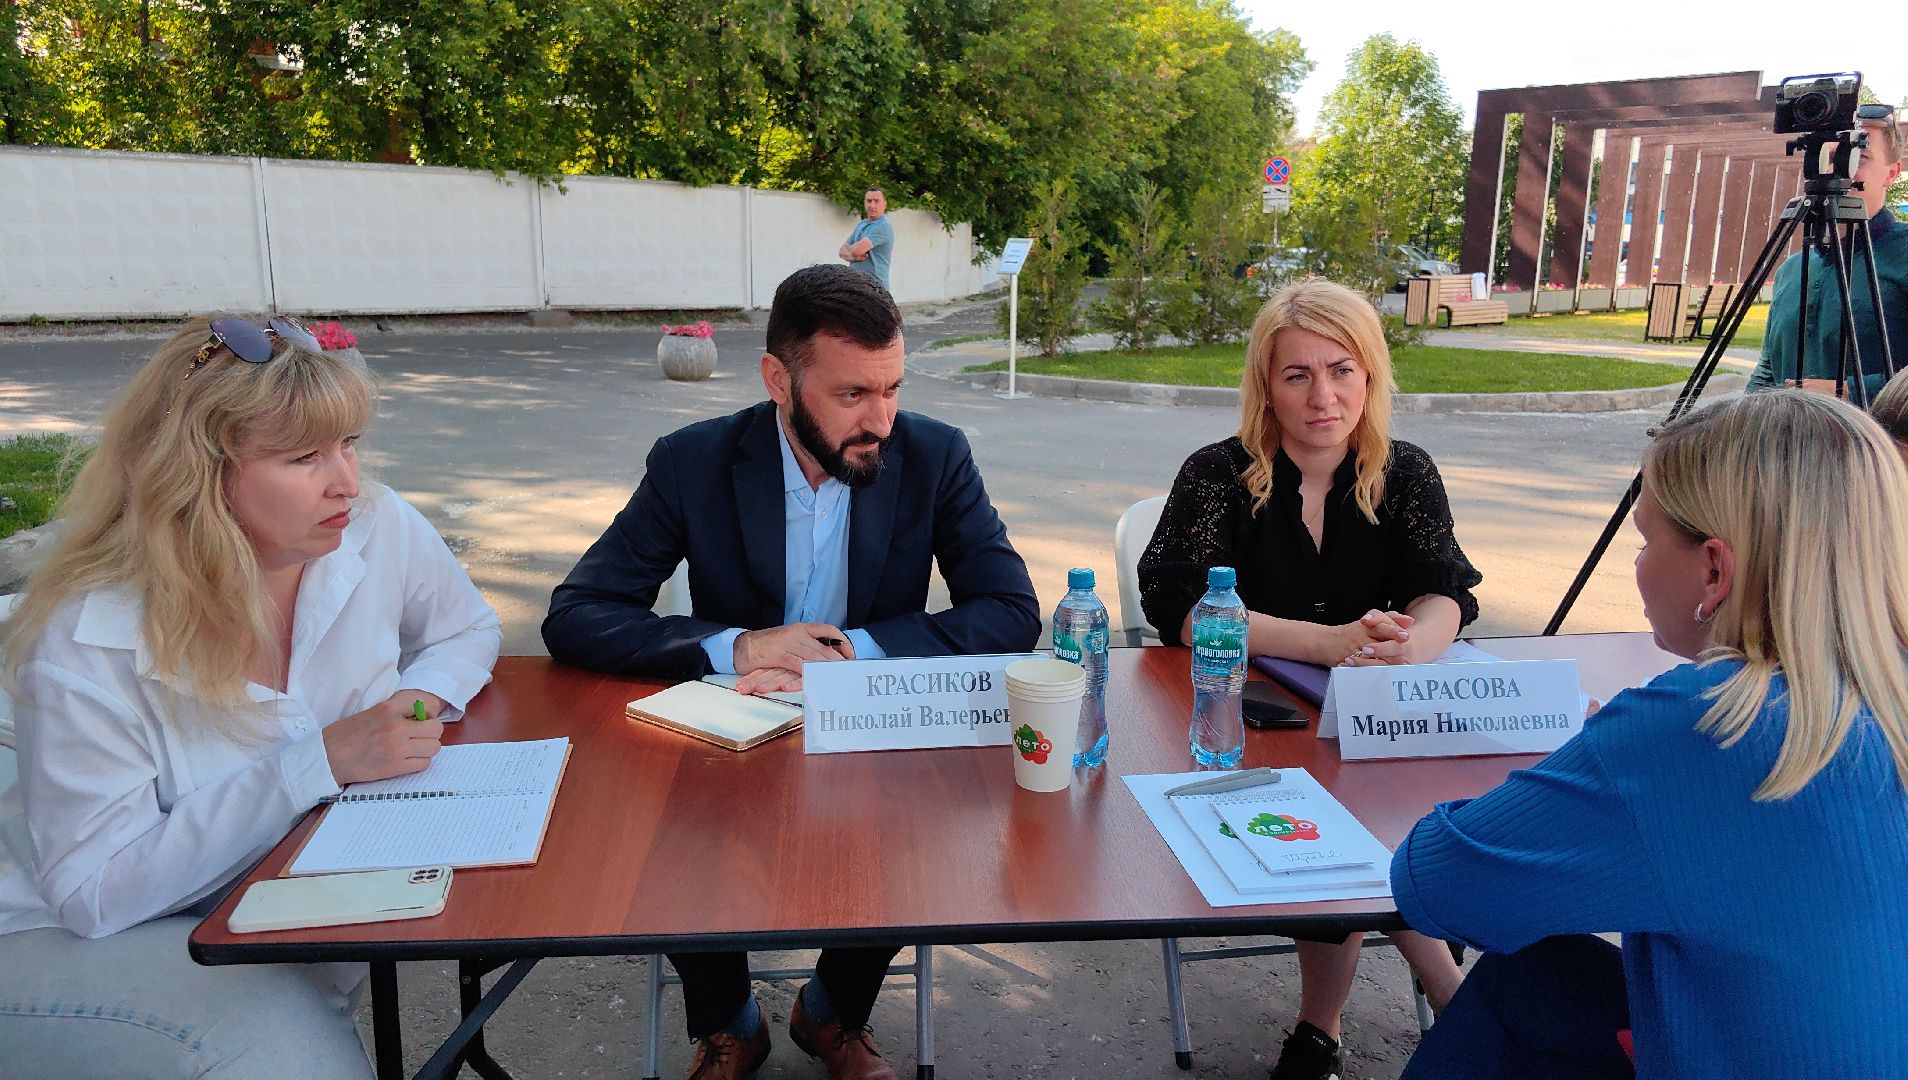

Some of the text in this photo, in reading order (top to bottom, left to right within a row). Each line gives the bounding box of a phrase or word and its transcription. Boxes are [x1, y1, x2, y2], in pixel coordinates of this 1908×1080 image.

[866, 670, 992, 697] КРАСИКОВ
[1392, 677, 1522, 702] ТАРАСОВА
[819, 706, 912, 732] Николай
[1351, 711, 1570, 741] Мария Николаевна
